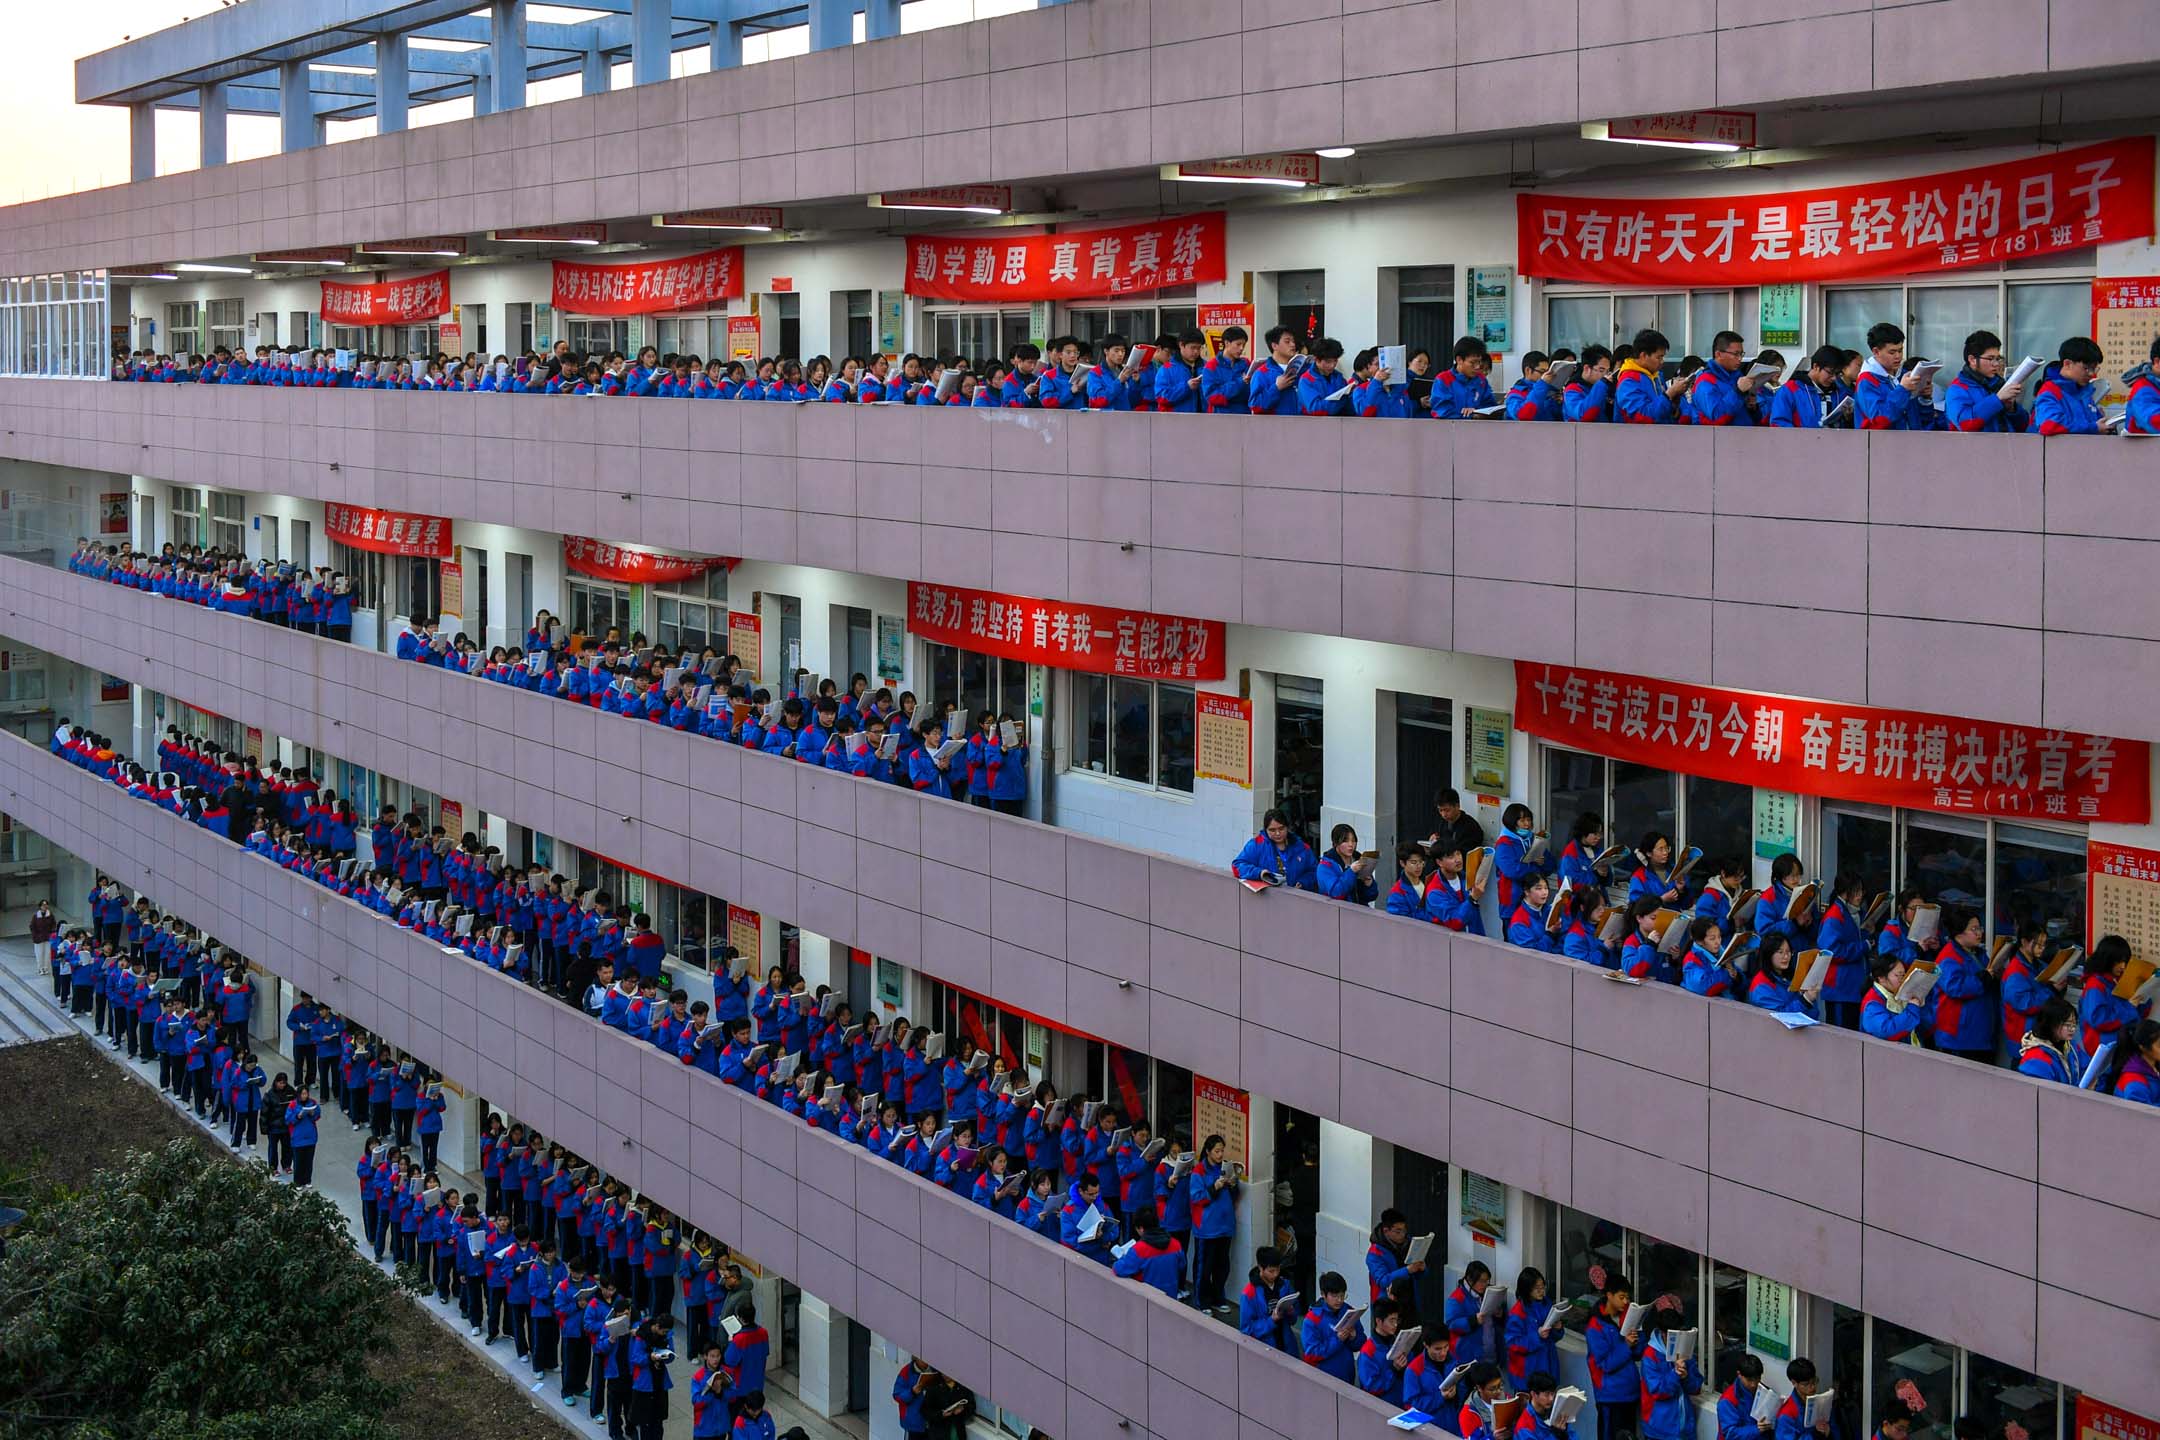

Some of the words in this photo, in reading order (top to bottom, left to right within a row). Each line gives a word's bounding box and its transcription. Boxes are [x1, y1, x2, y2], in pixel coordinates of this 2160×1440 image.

[1717, 127, 1743, 141] 651
[1284, 166, 1309, 177] 648
[1537, 156, 2122, 263] 只有昨天才是最轻松的日子
[914, 243, 1027, 285] 勤学勤思
[1049, 223, 1205, 283] 真背真练
[556, 269, 637, 302] 以梦为马怀壮志
[327, 504, 442, 545] 坚持比热血更重要
[915, 584, 962, 630] 我努力
[970, 598, 1023, 645] 我坚持
[1031, 607, 1208, 663] 首考我一定能成功
[1534, 665, 1785, 764] 十年苦读只为今朝
[1800, 711, 2117, 795] 奋勇拼搏决战首考
